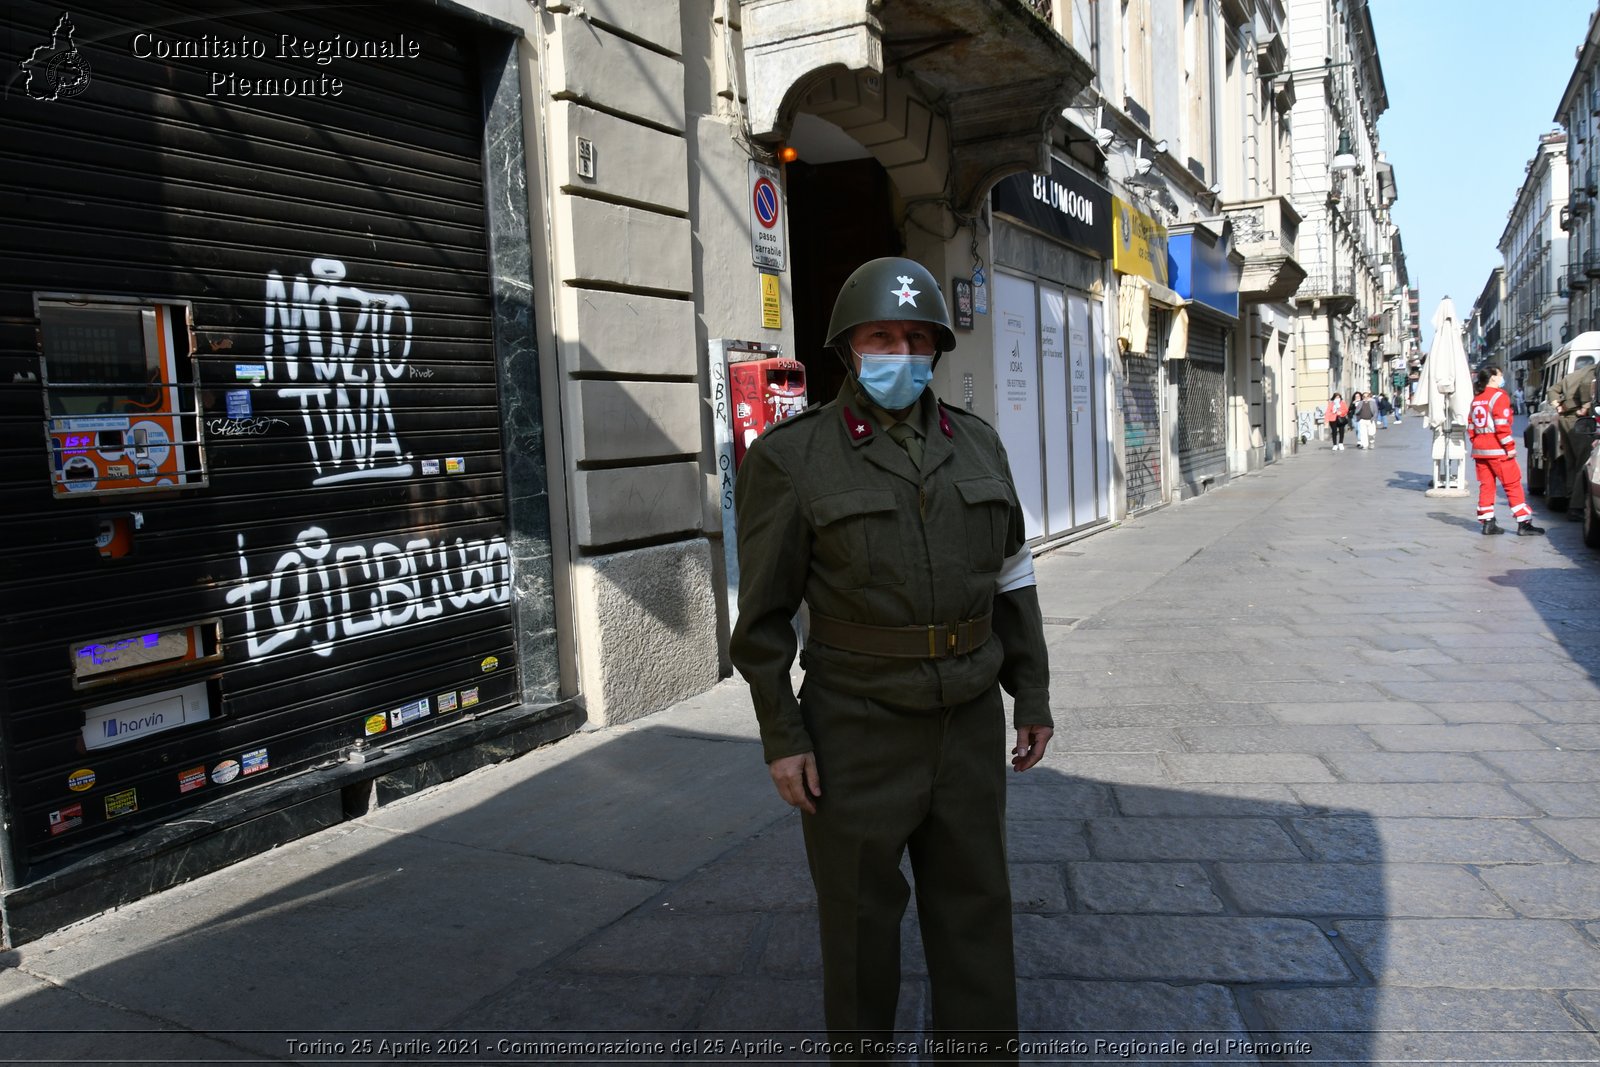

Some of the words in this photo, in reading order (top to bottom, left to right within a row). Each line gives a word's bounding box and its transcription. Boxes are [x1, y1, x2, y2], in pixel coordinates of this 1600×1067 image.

[1032, 174, 1093, 226] BLUMOON
[758, 231, 777, 242] passo
[755, 243, 782, 257] carrabile
[119, 712, 163, 735] harvin
